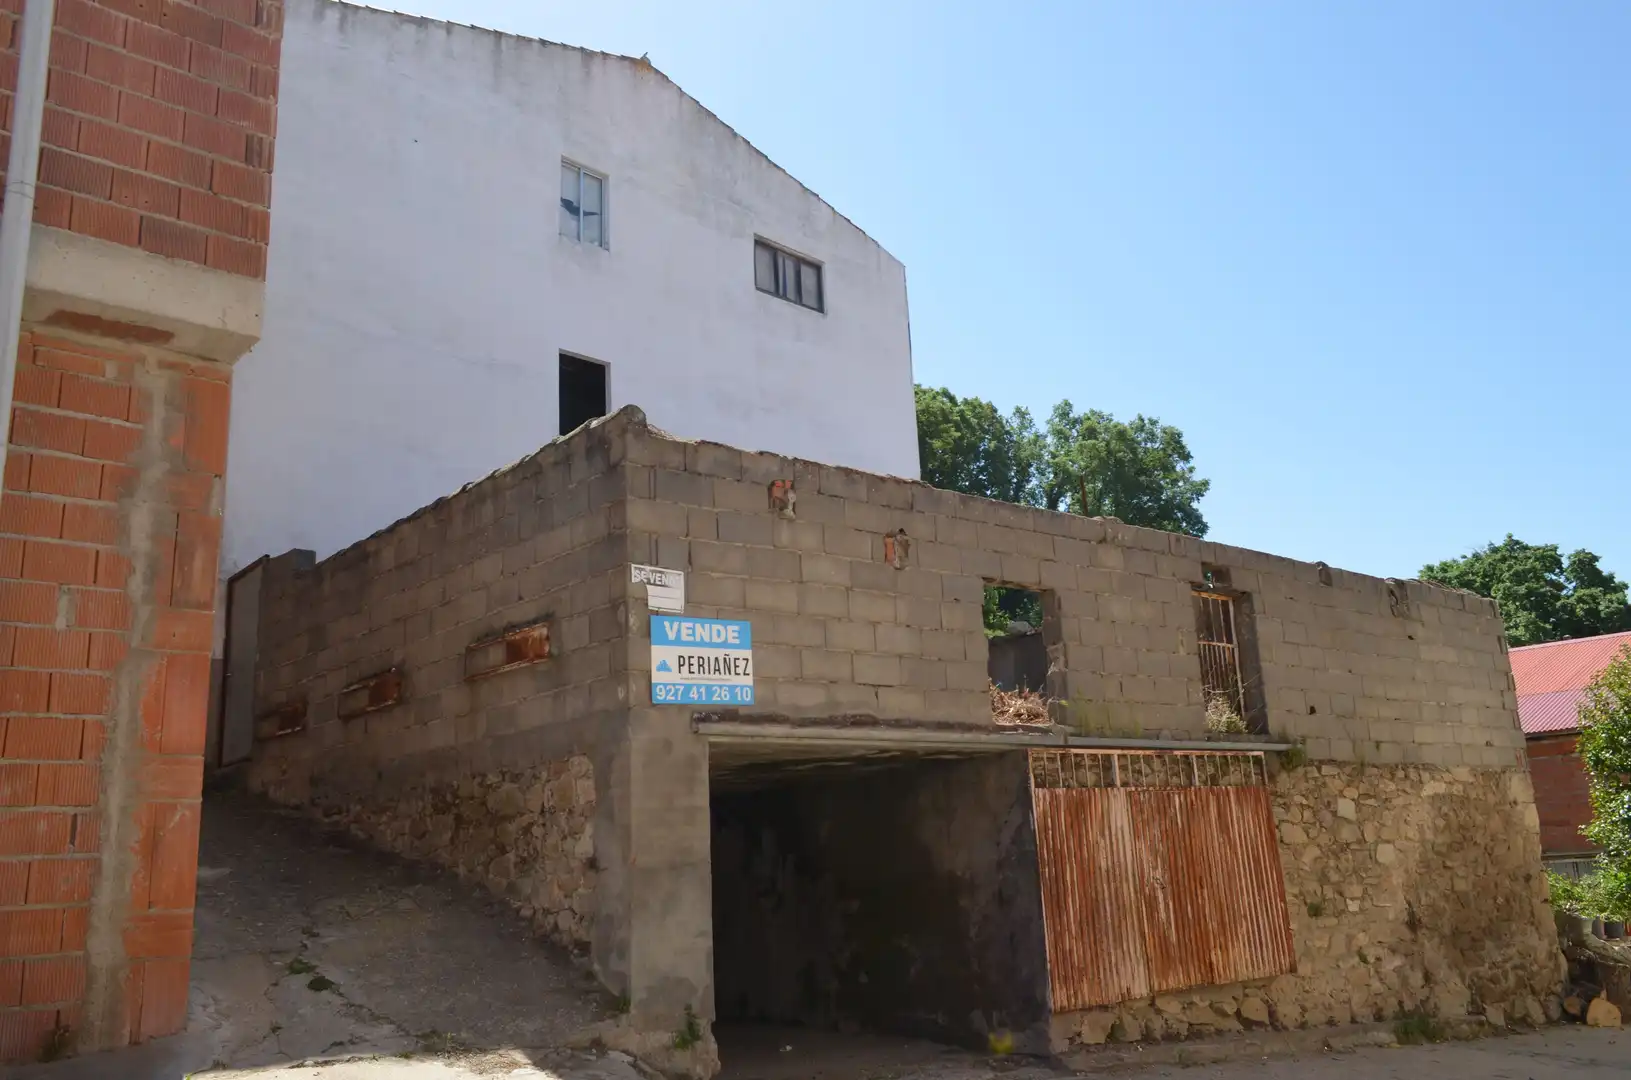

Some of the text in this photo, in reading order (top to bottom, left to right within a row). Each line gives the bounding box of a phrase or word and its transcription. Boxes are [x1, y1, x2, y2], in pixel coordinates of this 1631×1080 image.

[634, 569, 681, 586] SE VEN
[664, 621, 740, 644] VENDE
[677, 653, 750, 676] PERIAÑEZ
[656, 684, 751, 702] 927 41 26 10
